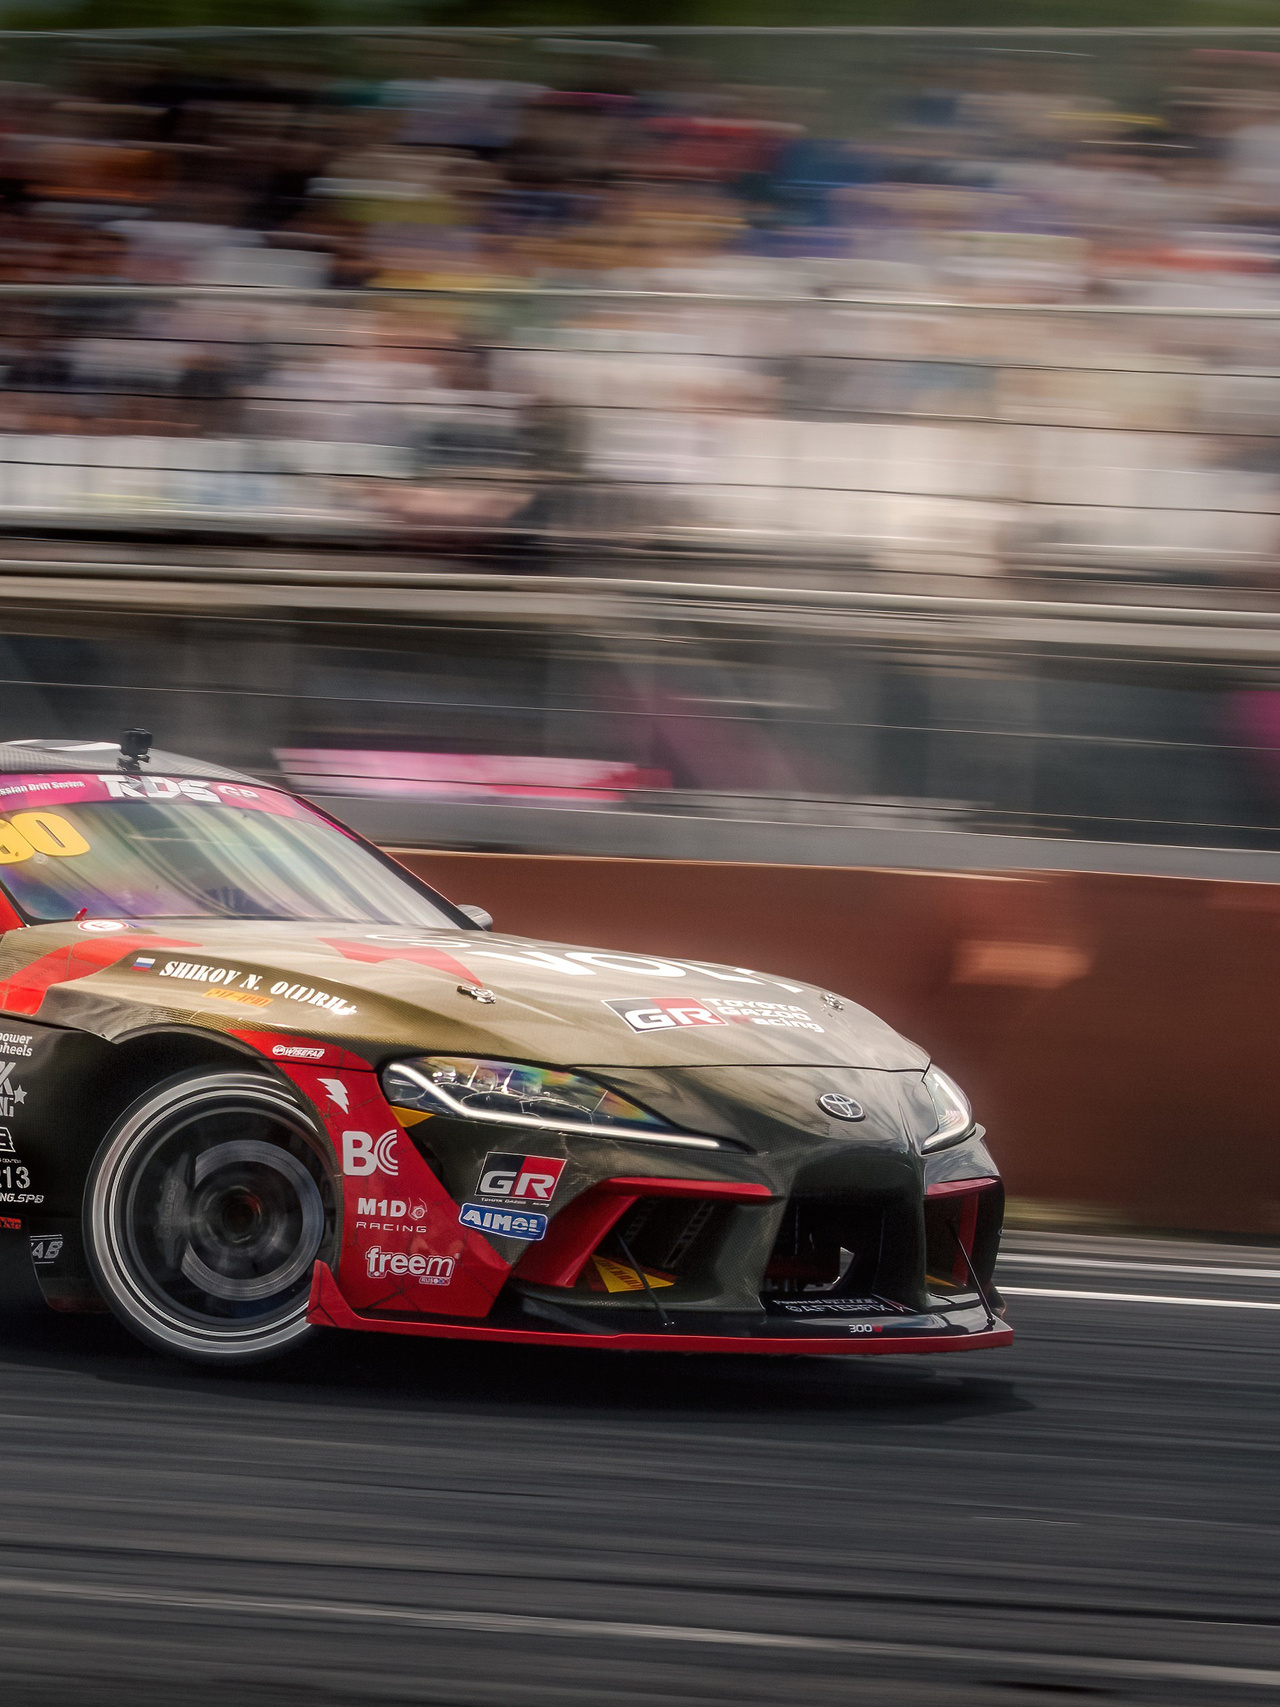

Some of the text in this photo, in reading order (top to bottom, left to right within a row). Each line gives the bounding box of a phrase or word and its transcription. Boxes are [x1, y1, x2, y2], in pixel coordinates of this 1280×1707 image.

[28, 782, 52, 791] Drift
[97, 774, 221, 803] RDS
[159, 961, 241, 986] SHIKOV
[240, 974, 264, 991] N.
[701, 998, 809, 1014] TOYOTA
[717, 1006, 812, 1021] GAZOO
[626, 1008, 720, 1028] GR
[479, 1170, 556, 1199] GR
[357, 1197, 407, 1218] M1D
[356, 1221, 427, 1233] RACING
[462, 1209, 542, 1234] AIMOL
[366, 1248, 455, 1278] freem
